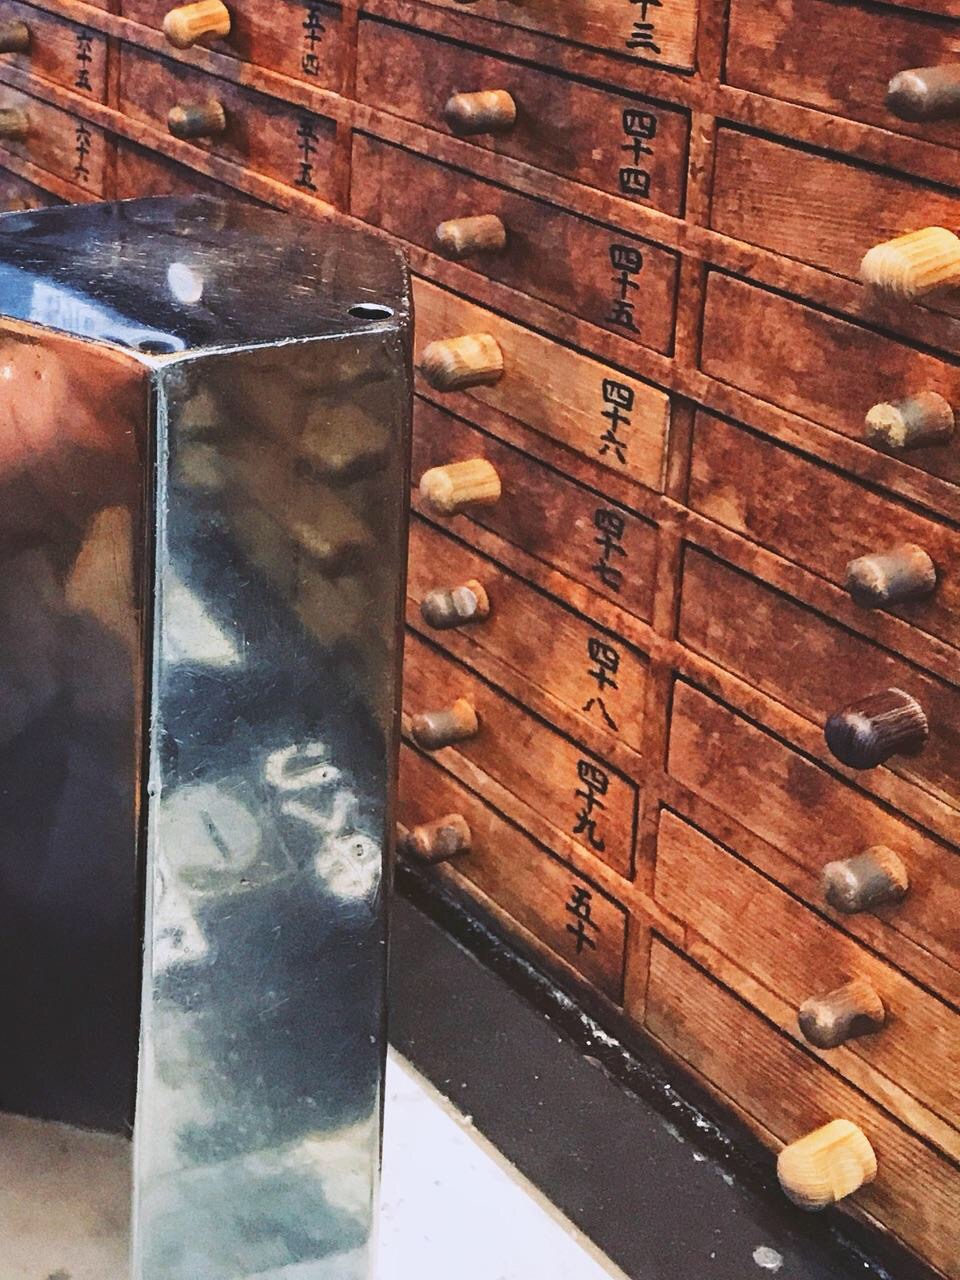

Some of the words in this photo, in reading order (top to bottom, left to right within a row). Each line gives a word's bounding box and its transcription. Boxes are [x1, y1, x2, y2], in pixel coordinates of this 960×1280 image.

[74, 29, 93, 92] 六十五
[302, 5, 325, 76] 五十四
[74, 123, 92, 182] 六十六
[294, 119, 320, 192] 五十五
[618, 107, 658, 199] 四十四
[606, 243, 644, 335] 四十五
[597, 377, 636, 465] 四十六
[592, 507, 629, 594] 四十七
[581, 636, 620, 732] 四十八
[572, 758, 610, 853] 四十九
[564, 883, 601, 955] 五十
